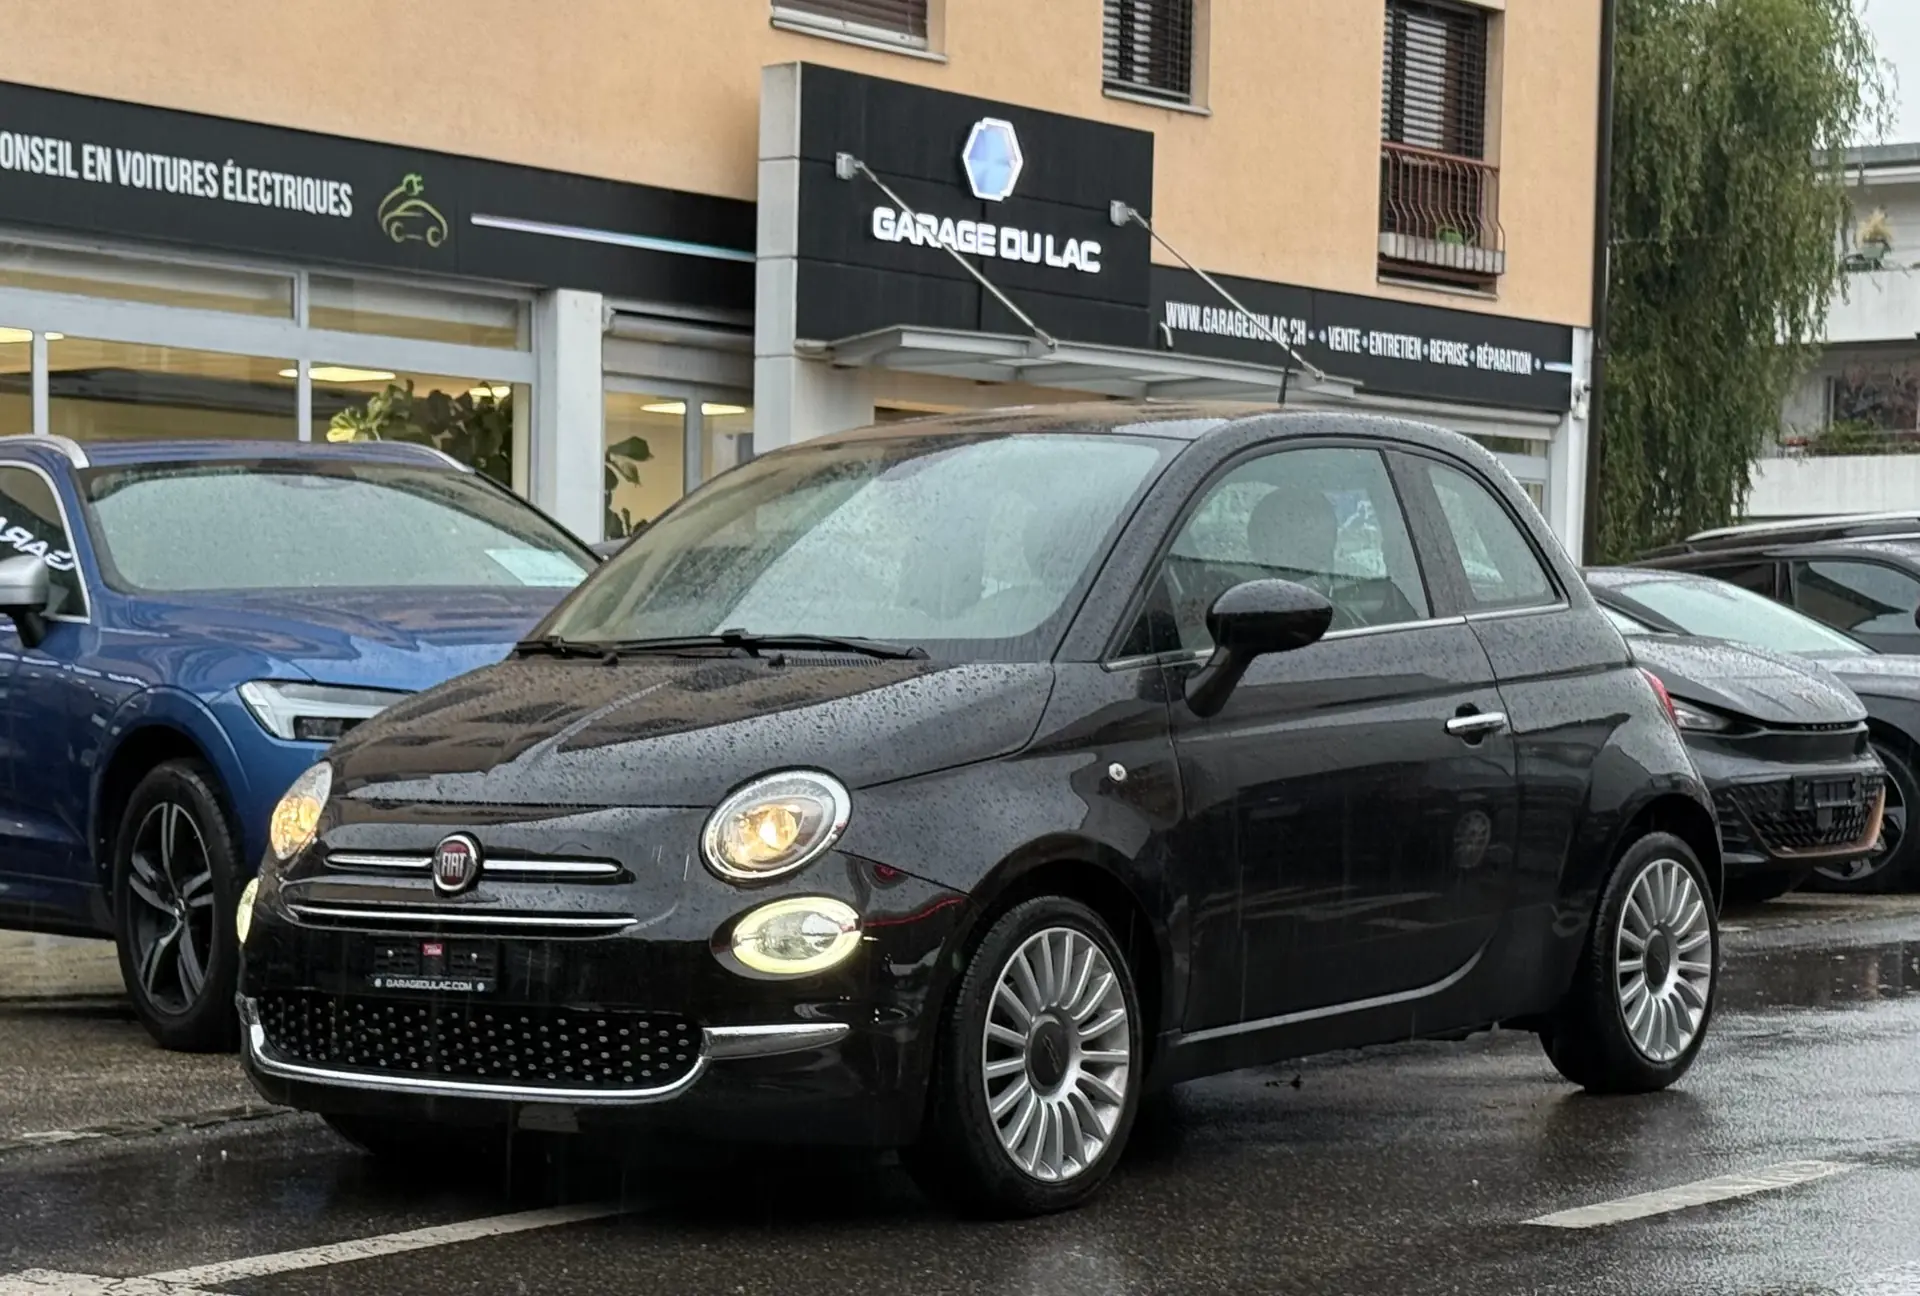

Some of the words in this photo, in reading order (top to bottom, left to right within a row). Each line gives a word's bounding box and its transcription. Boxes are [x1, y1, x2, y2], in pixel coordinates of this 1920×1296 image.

[0, 130, 79, 179] ONSEIL
[82, 143, 112, 183] EN
[116, 149, 219, 199] VOITURES
[222, 158, 353, 218] ÉLECTRIQUES
[873, 206, 996, 257] GARAGE
[1000, 227, 1041, 264] DU
[1045, 234, 1101, 273] LAC
[1165, 301, 1306, 346] WWW.GARAGEDULAC.CH
[1328, 325, 1361, 354] VENTE
[1369, 334, 1422, 361] ENTRETIEN
[1430, 338, 1469, 367] REPRISE
[1476, 341, 1532, 375] RÉPARATION
[441, 851, 467, 877] FIAT
[386, 979, 473, 991] GARAGEDULAC.COM
